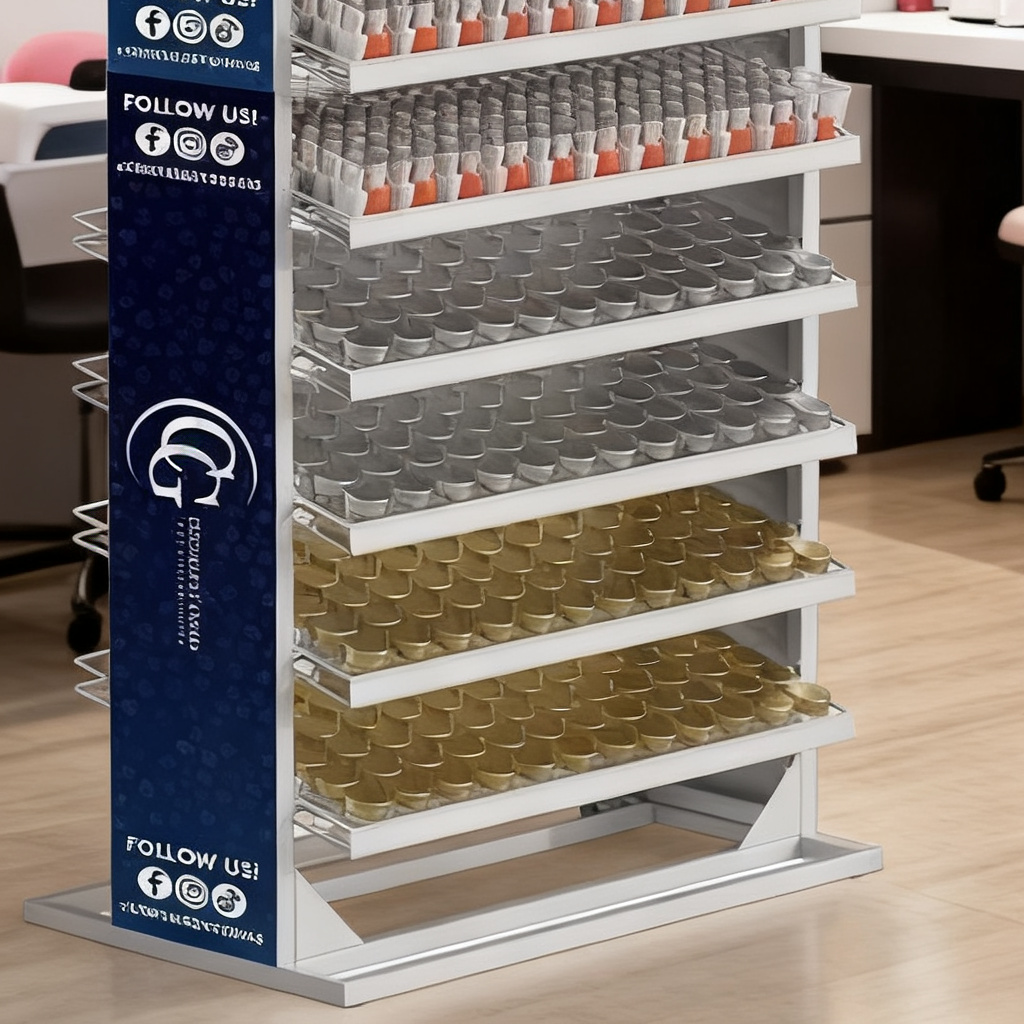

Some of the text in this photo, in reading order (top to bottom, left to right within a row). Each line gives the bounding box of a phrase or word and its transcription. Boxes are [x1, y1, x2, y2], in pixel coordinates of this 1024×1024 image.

[123, 92, 258, 126] FOLLOW US!
[126, 835, 218, 871] FOLLOW
